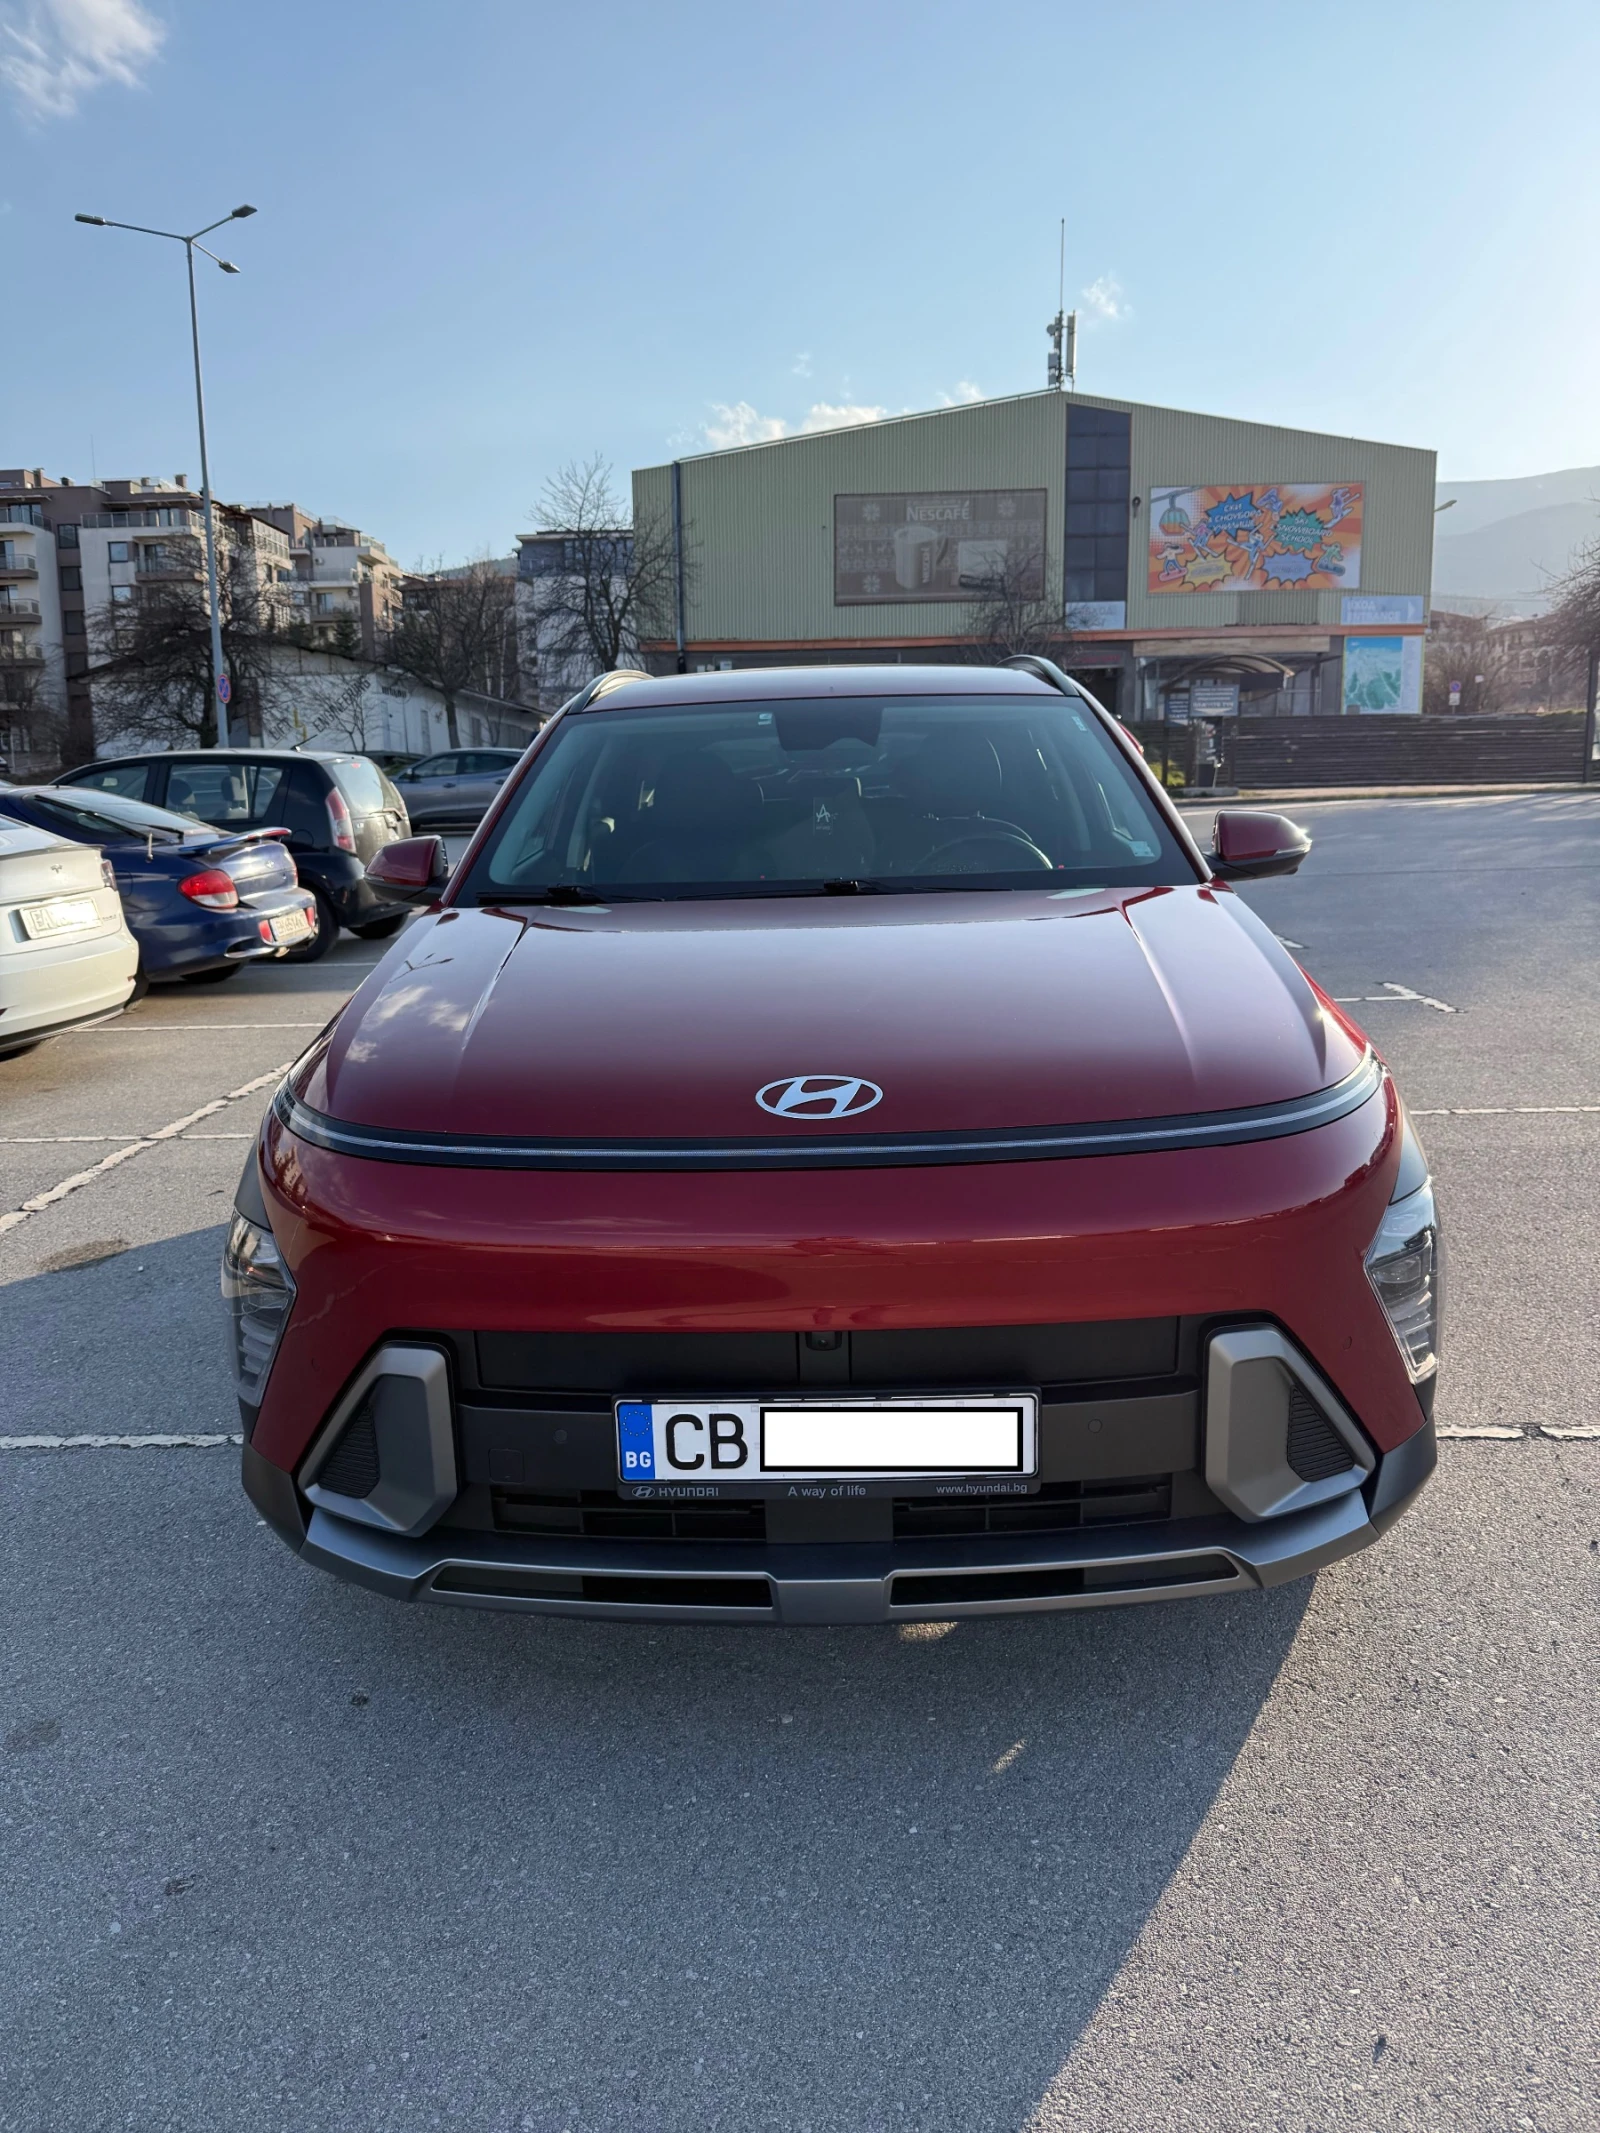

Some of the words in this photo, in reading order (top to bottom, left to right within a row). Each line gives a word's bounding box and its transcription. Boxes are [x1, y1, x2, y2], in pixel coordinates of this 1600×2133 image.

[906, 500, 970, 521] NESCAFÉ
[1276, 524, 1333, 537] SNOWBOARD
[1280, 534, 1315, 544] SCHOOL
[268, 717, 293, 741] LIFT
[312, 674, 371, 733] ENGINEERING
[665, 1413, 749, 1471] CB
[625, 1451, 652, 1469] BG
[658, 1487, 719, 1497] HYUNDAI
[787, 1487, 798, 1497] A
[801, 1487, 826, 1497] way
[830, 1486, 844, 1497] of
[847, 1485, 867, 1496] life
[935, 1483, 1029, 1494] www.hyundai.bg
